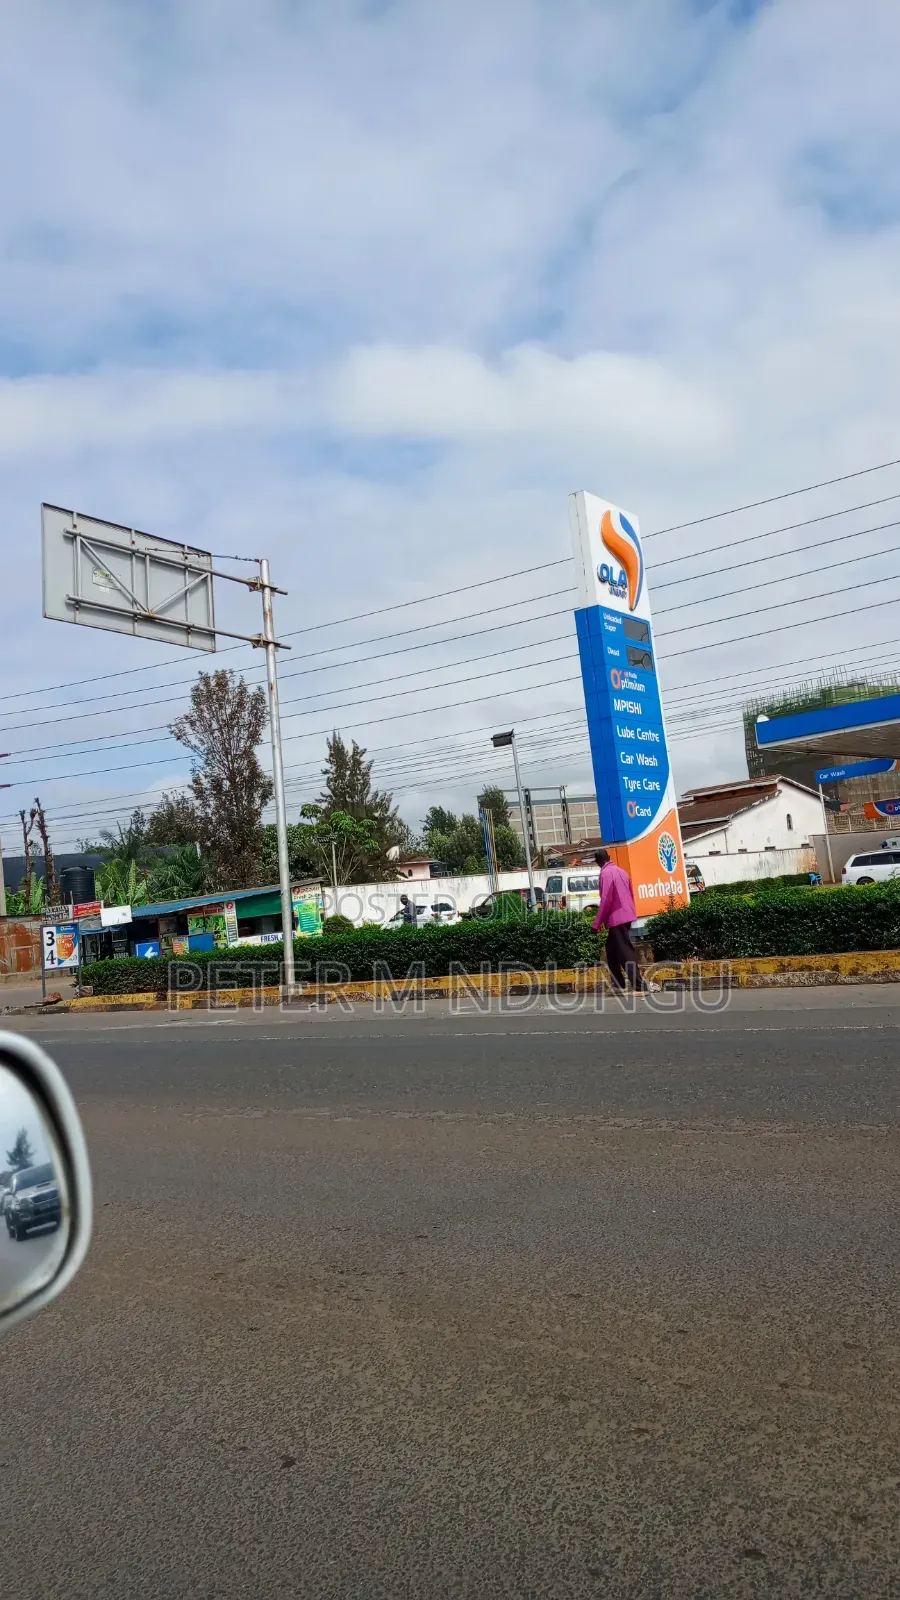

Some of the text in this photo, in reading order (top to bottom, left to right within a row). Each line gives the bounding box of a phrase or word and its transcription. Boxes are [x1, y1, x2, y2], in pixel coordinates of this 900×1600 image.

[598, 563, 628, 590] OLA
[613, 698, 642, 715] MPISHI
[616, 724, 660, 743] Lube Centre
[620, 751, 659, 767] Car Wash
[830, 769, 846, 778] Wash
[623, 776, 661, 793] Tyre Care
[638, 875, 683, 900] marhaba
[46, 931, 56, 947] 3
[260, 934, 278, 943] FRESH
[46, 949, 56, 965] 4
